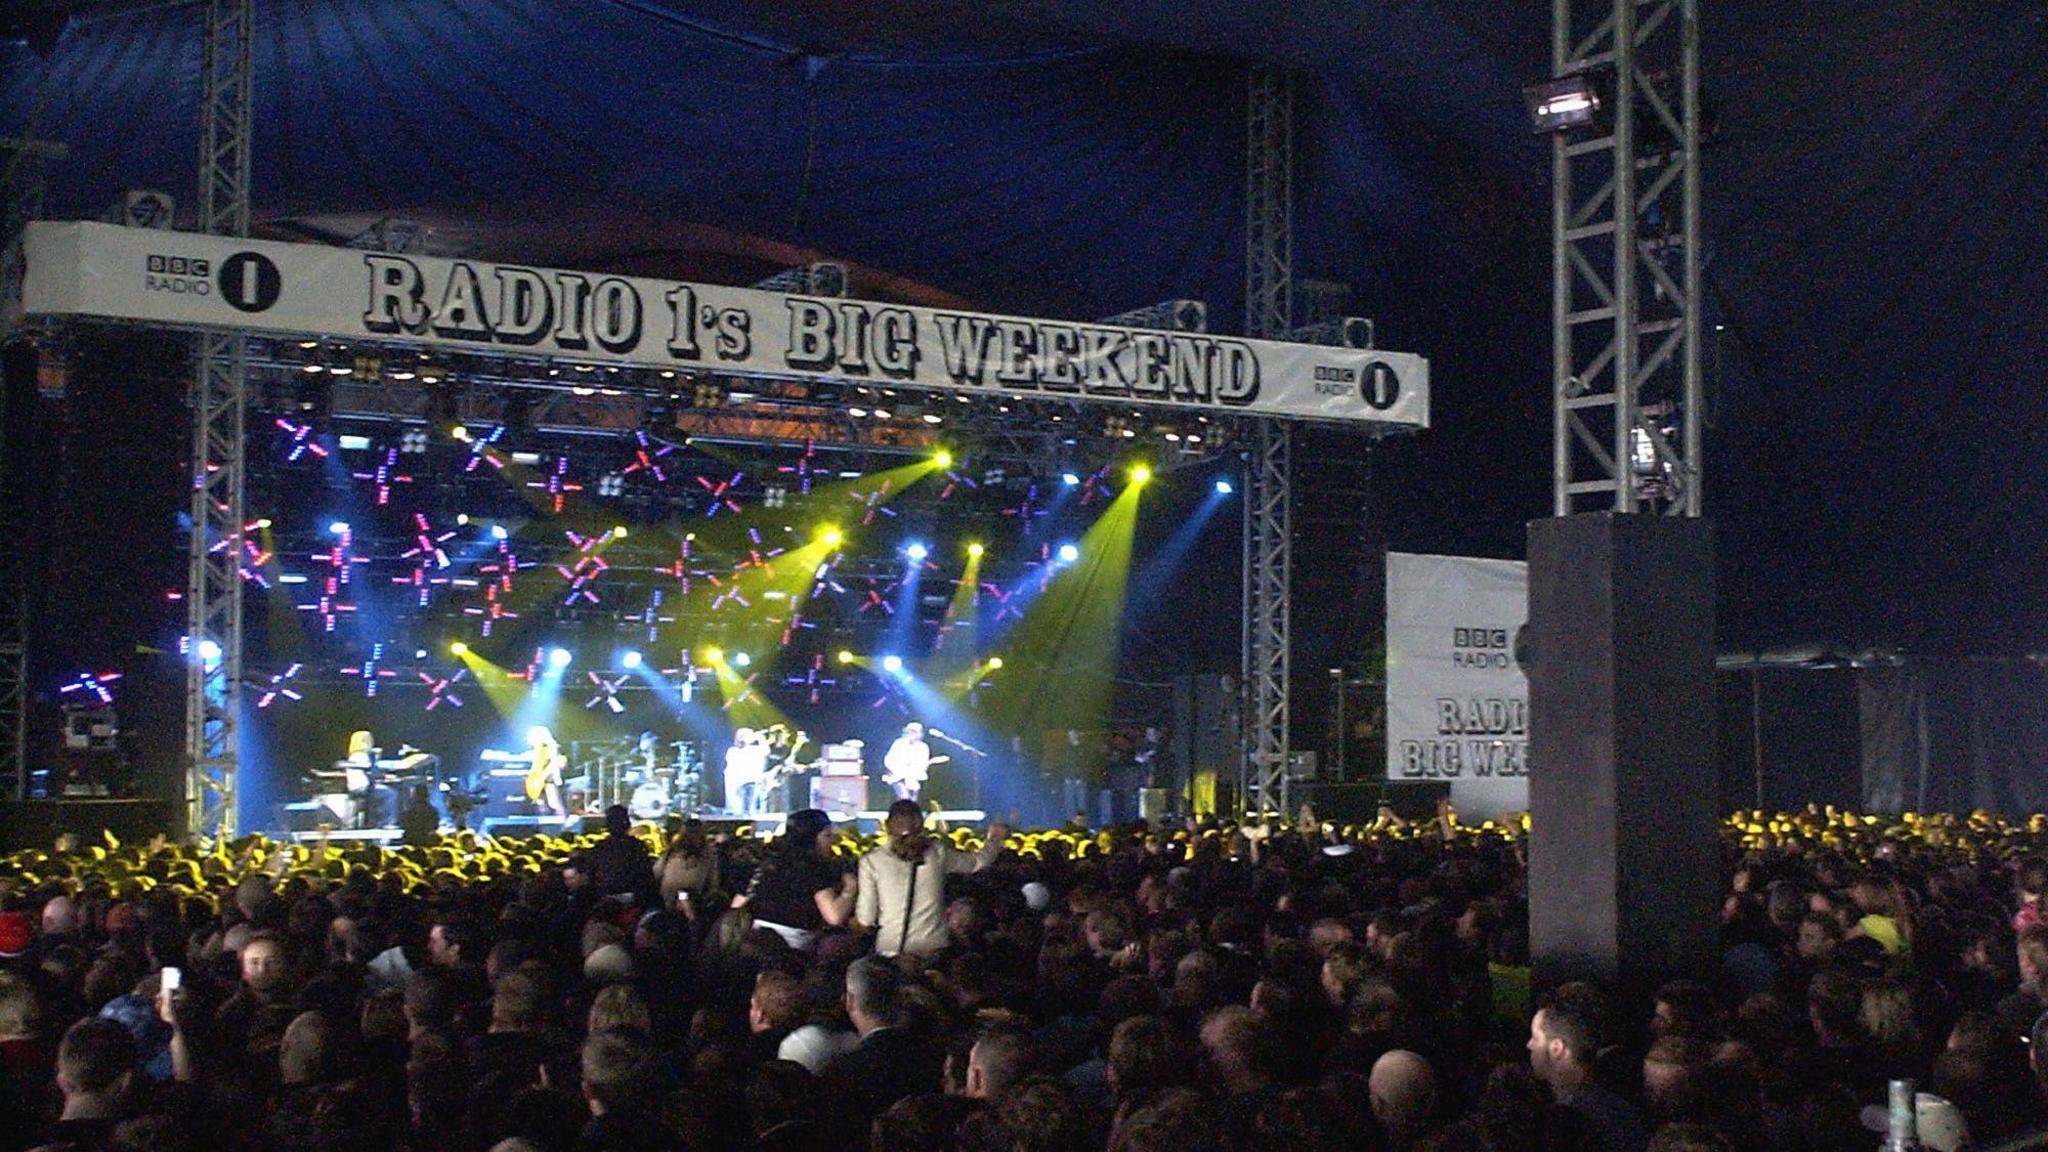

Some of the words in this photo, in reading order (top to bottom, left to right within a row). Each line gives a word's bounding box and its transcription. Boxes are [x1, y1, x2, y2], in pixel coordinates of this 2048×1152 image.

[147, 255, 209, 277] BBC
[146, 275, 210, 296] RADIO
[364, 254, 643, 354] RADIO
[785, 298, 921, 380] BIG
[934, 313, 1261, 406] WEEKEND
[1455, 628, 1506, 648] BBC
[1453, 652, 1508, 669] RADIO
[1401, 739, 1460, 777] BIG
